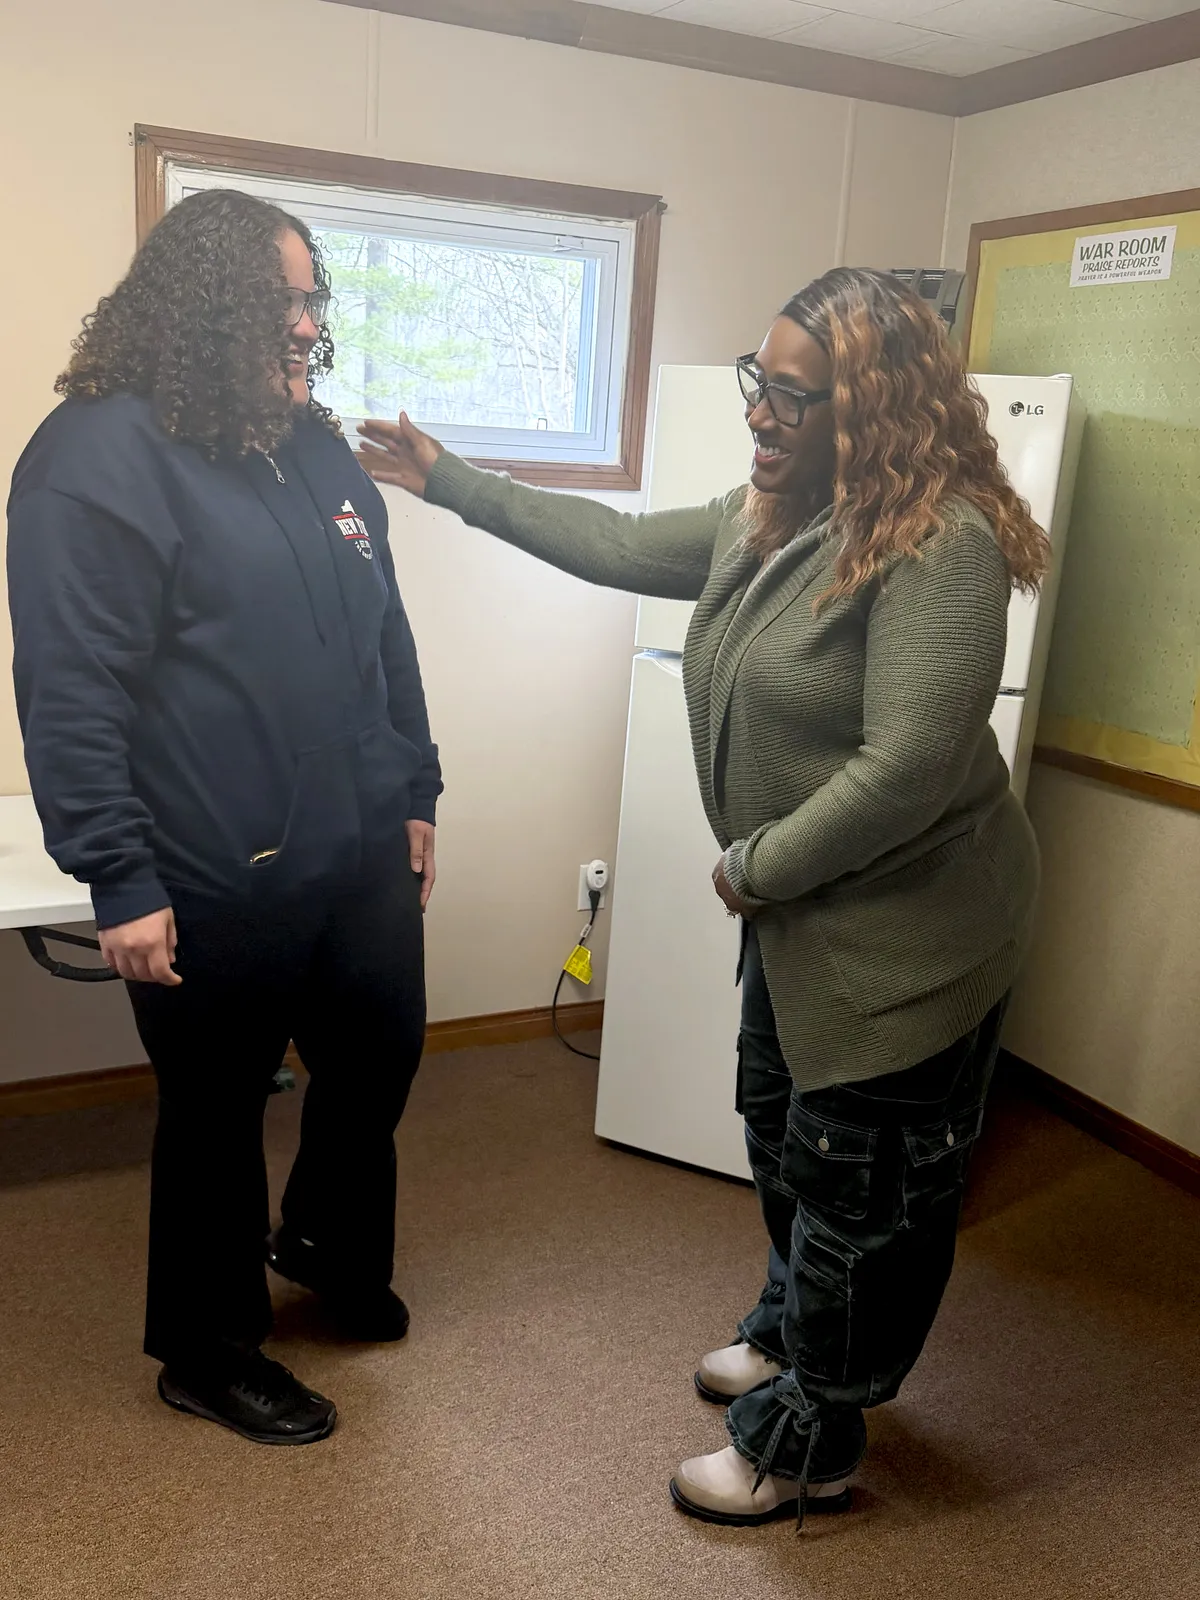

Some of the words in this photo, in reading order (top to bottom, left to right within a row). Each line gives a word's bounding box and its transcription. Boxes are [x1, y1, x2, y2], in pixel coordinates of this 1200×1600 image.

[1080, 242, 1114, 261] WAR
[1119, 235, 1167, 257] ROOM
[1082, 260, 1114, 273] PRAISE
[1115, 255, 1160, 270] REPORTS
[1026, 404, 1044, 416] LG
